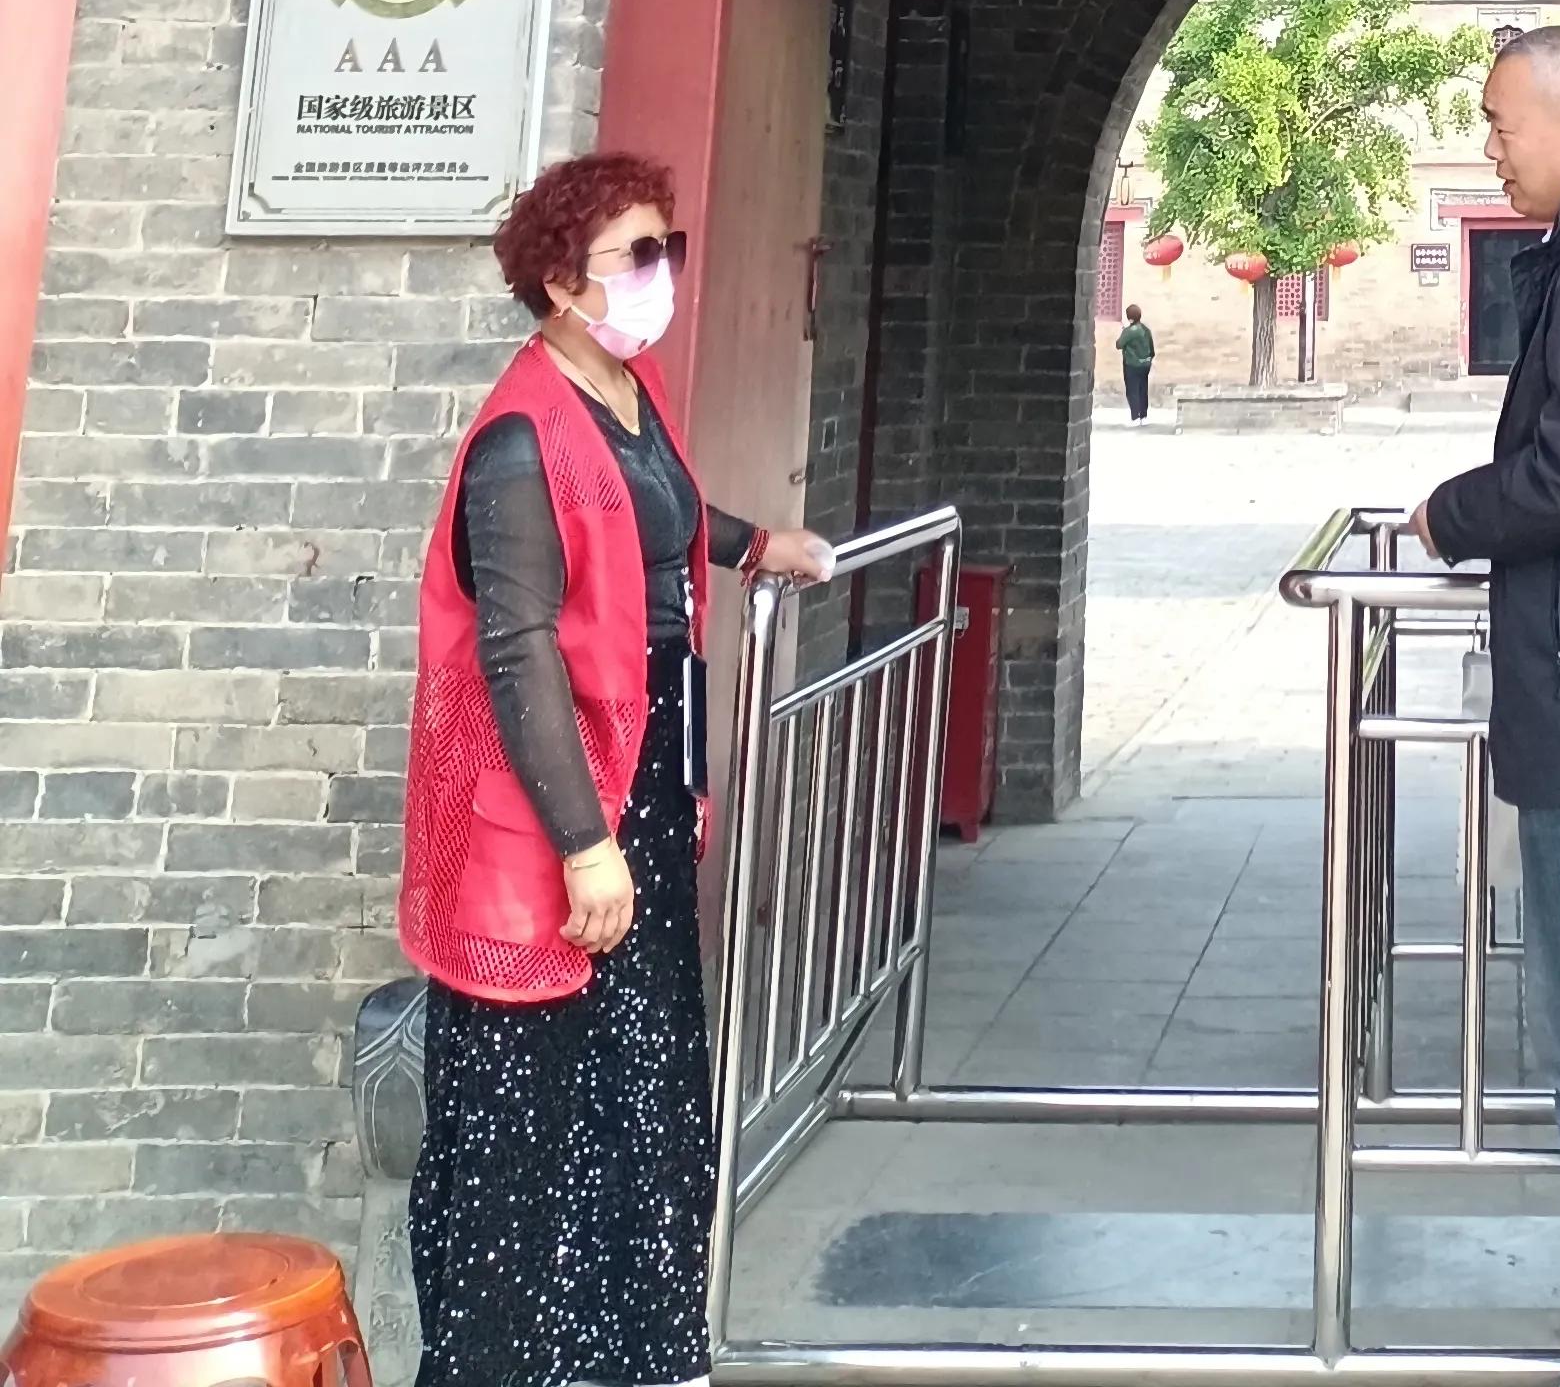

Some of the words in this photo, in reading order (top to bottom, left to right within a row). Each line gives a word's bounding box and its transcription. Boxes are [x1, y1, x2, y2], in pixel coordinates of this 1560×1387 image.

[297, 94, 477, 121] 国家级旅游景区
[296, 124, 352, 135] NATIONAL
[355, 124, 402, 135] TOURIST
[404, 124, 474, 135] ATTRACTION
